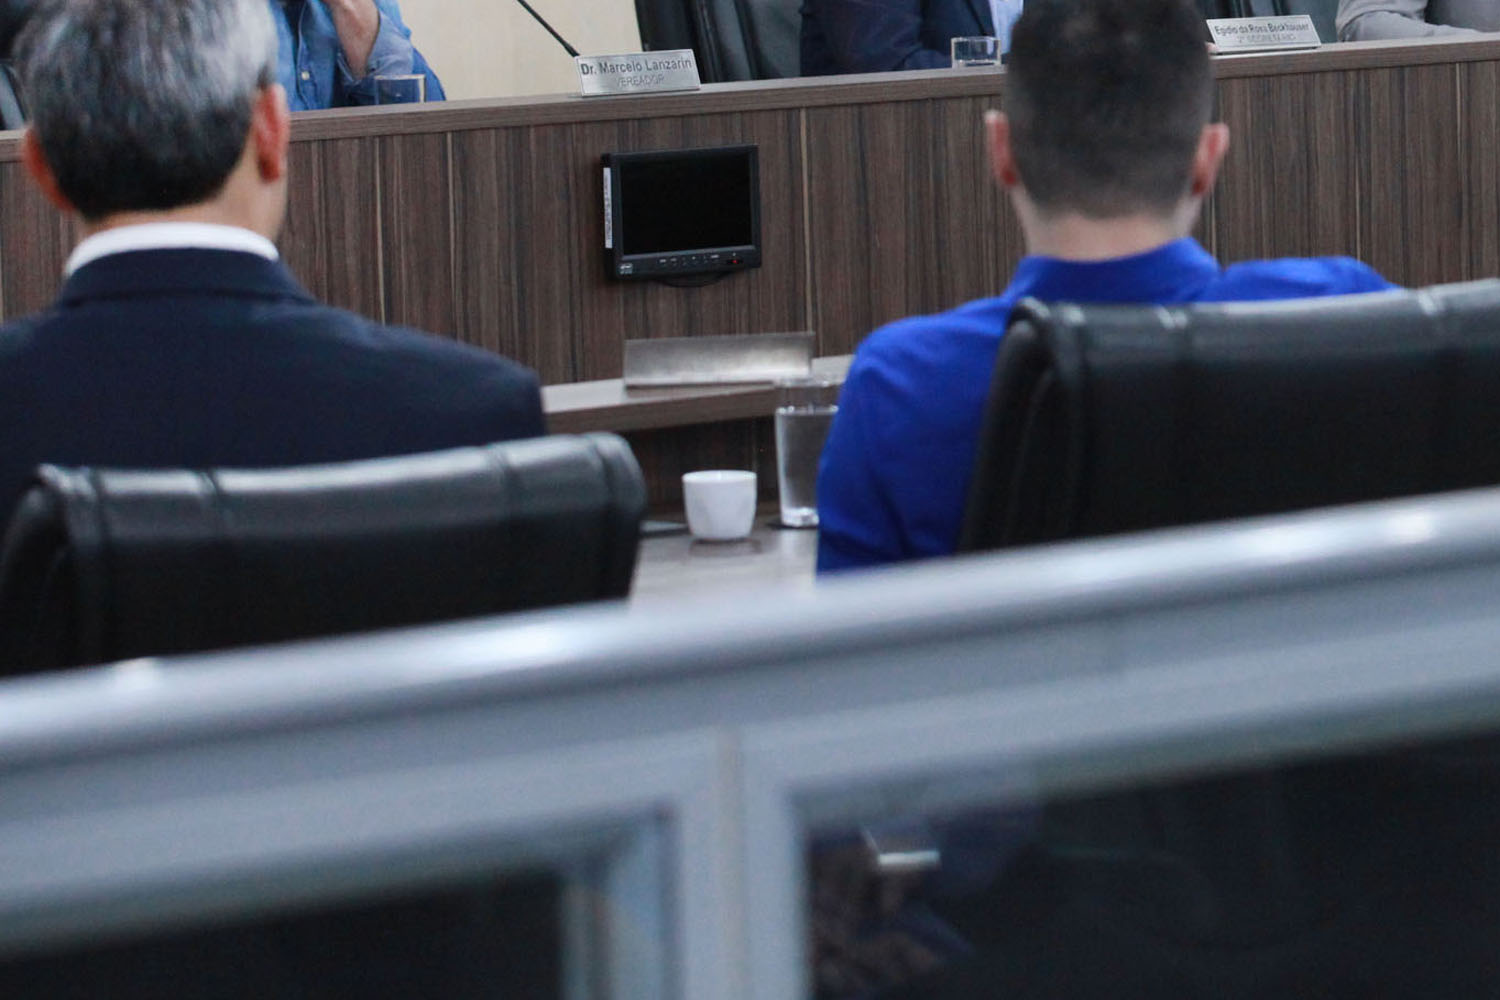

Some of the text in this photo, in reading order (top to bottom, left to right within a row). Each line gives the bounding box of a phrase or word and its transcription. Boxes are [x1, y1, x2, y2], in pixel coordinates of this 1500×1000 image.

[580, 58, 692, 75] Dr. Marcelo Lanzarin
[616, 74, 664, 87] VEREADOR
